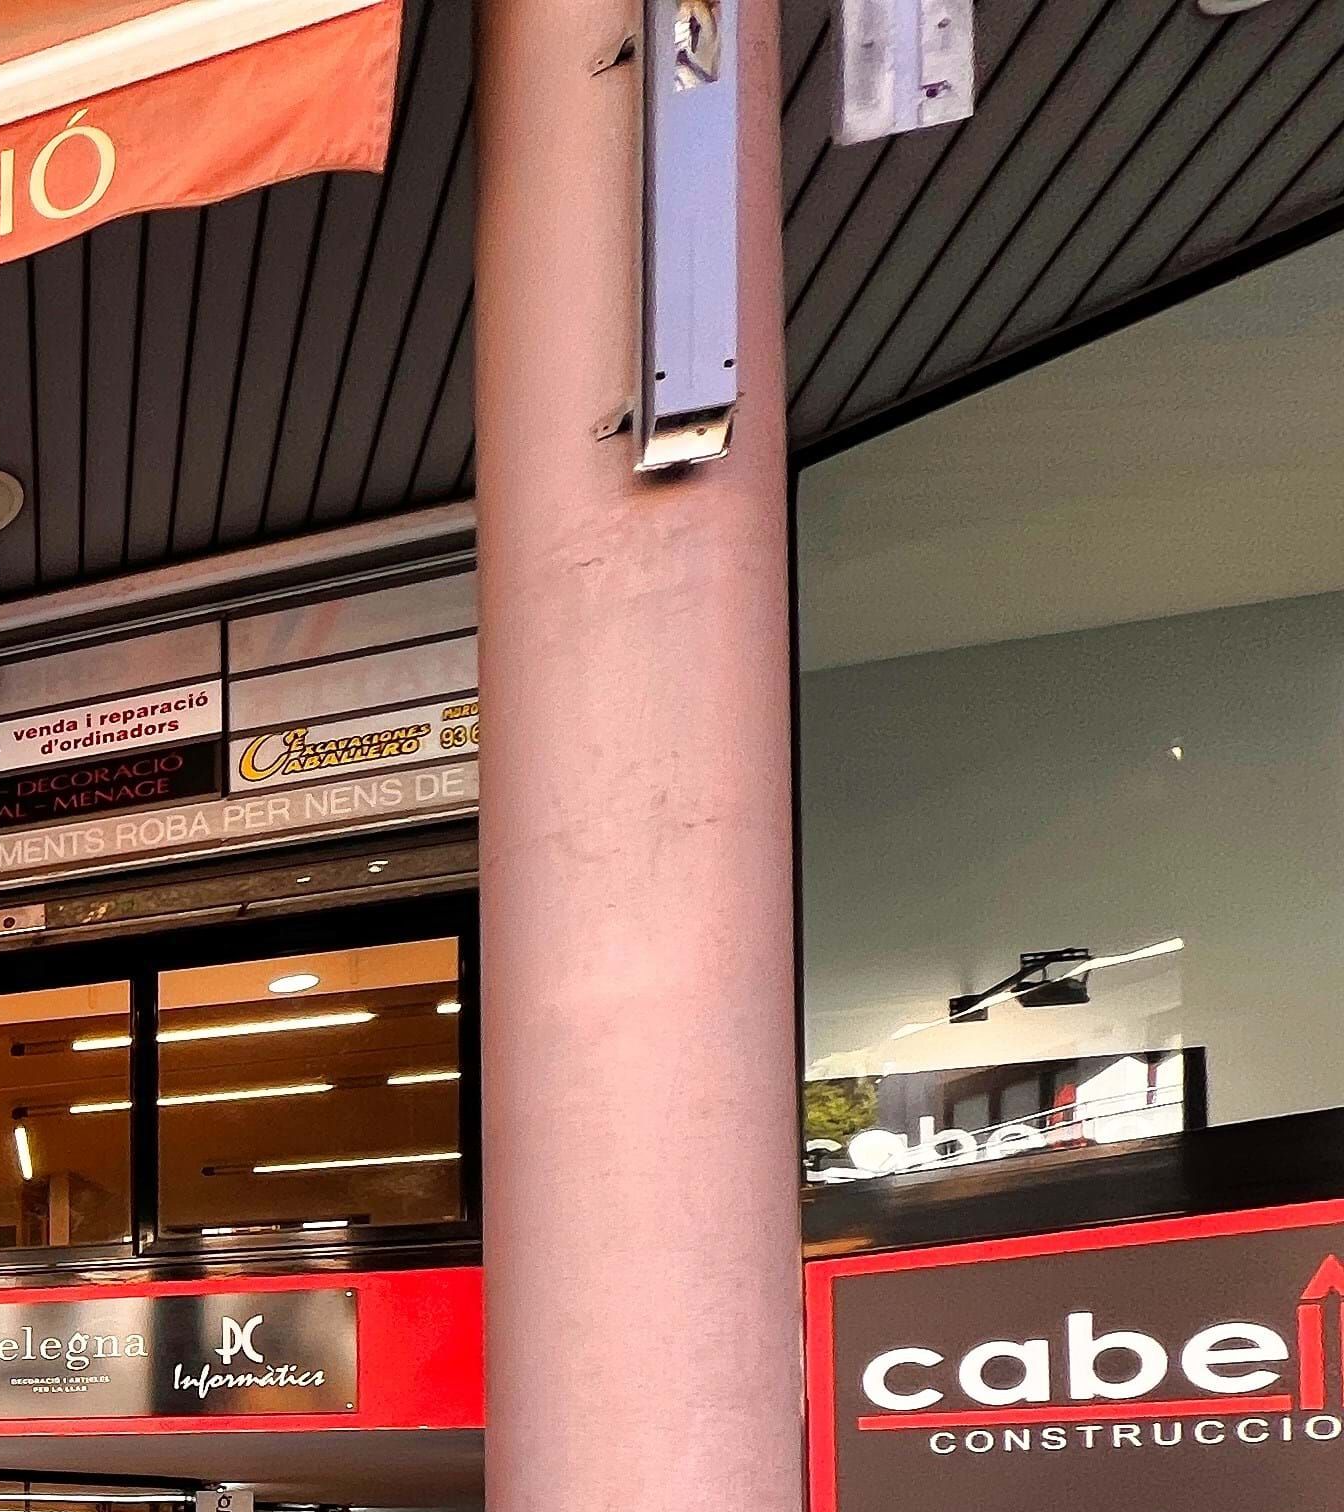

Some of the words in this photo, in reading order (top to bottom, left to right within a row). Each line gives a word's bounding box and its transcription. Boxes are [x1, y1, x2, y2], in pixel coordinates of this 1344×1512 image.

[12, 718, 78, 743] venda
[86, 714, 92, 729] i
[99, 691, 209, 728] reparació
[40, 718, 180, 757] d'ordinadors
[440, 725, 467, 750] 93
[239, 733, 421, 782] CABALLERO
[288, 722, 432, 756] EXCAVACIONES
[17, 753, 184, 798] DECORACIÓ
[52, 778, 170, 813] MENAGE
[116, 805, 211, 849] ROBA
[223, 797, 291, 831] PER
[304, 780, 404, 819] NENS
[415, 767, 465, 801] DE
[214, 1314, 264, 1365] PC
[172, 1364, 326, 1399] Informàtics
